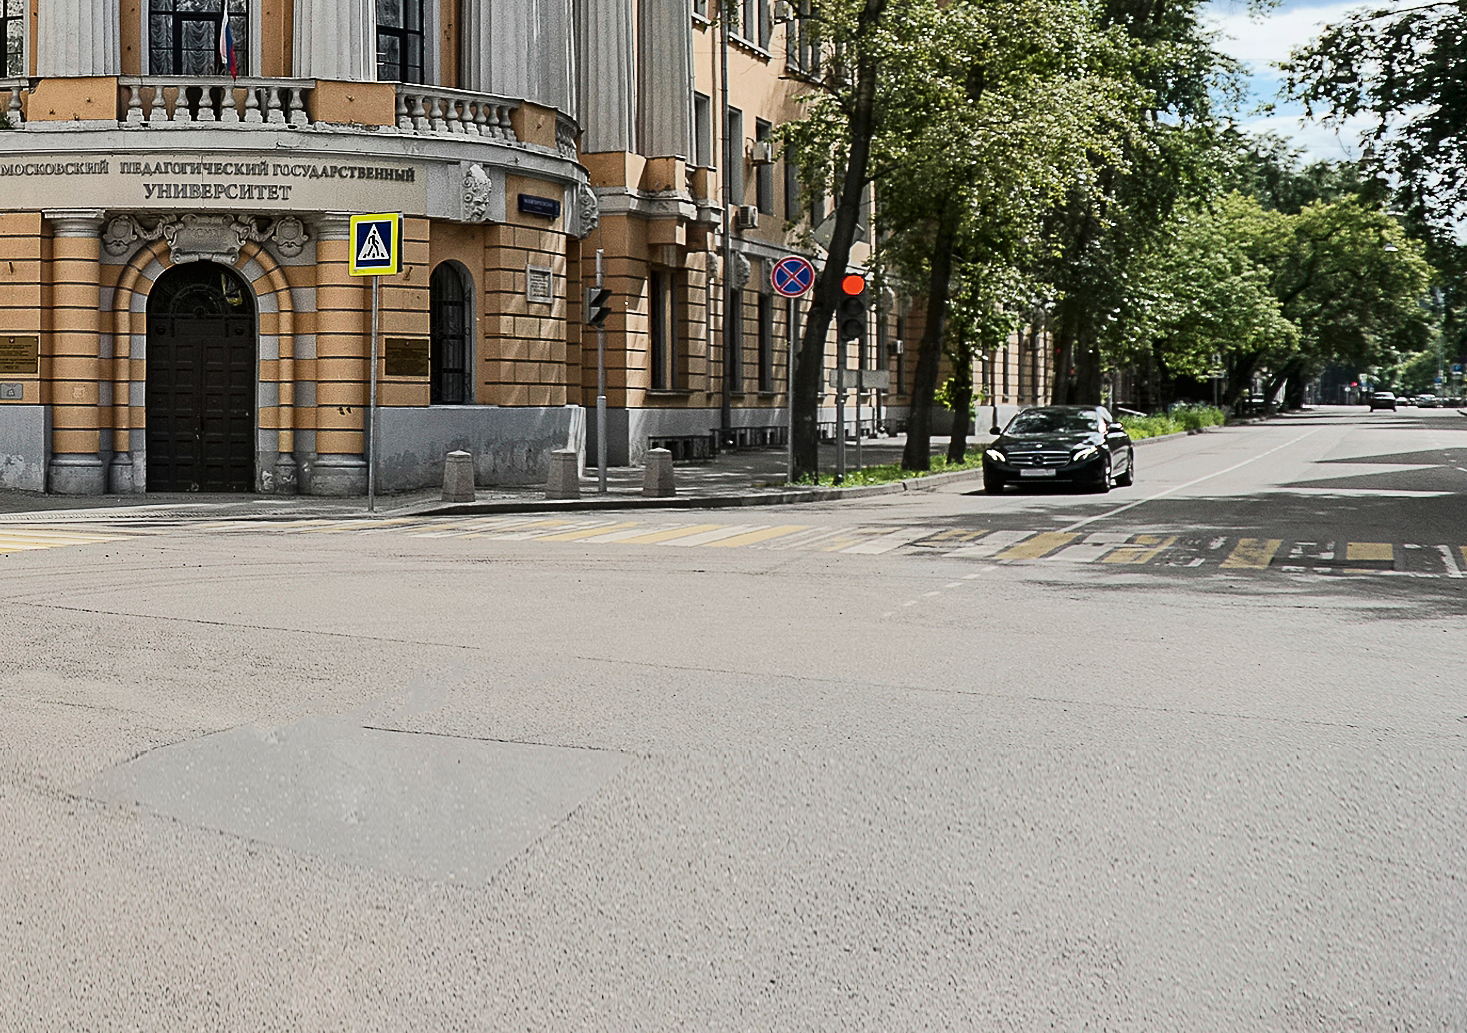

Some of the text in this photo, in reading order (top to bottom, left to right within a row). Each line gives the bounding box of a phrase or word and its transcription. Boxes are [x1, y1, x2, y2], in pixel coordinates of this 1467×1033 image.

[0, 159, 416, 182] МОСКОВСКИЙ ПЕДАГОГИЧЕСКИЙ ГОСУДАРСТВЕННЫЙ
[143, 183, 292, 201] УНИВЕРСИТЕТ
